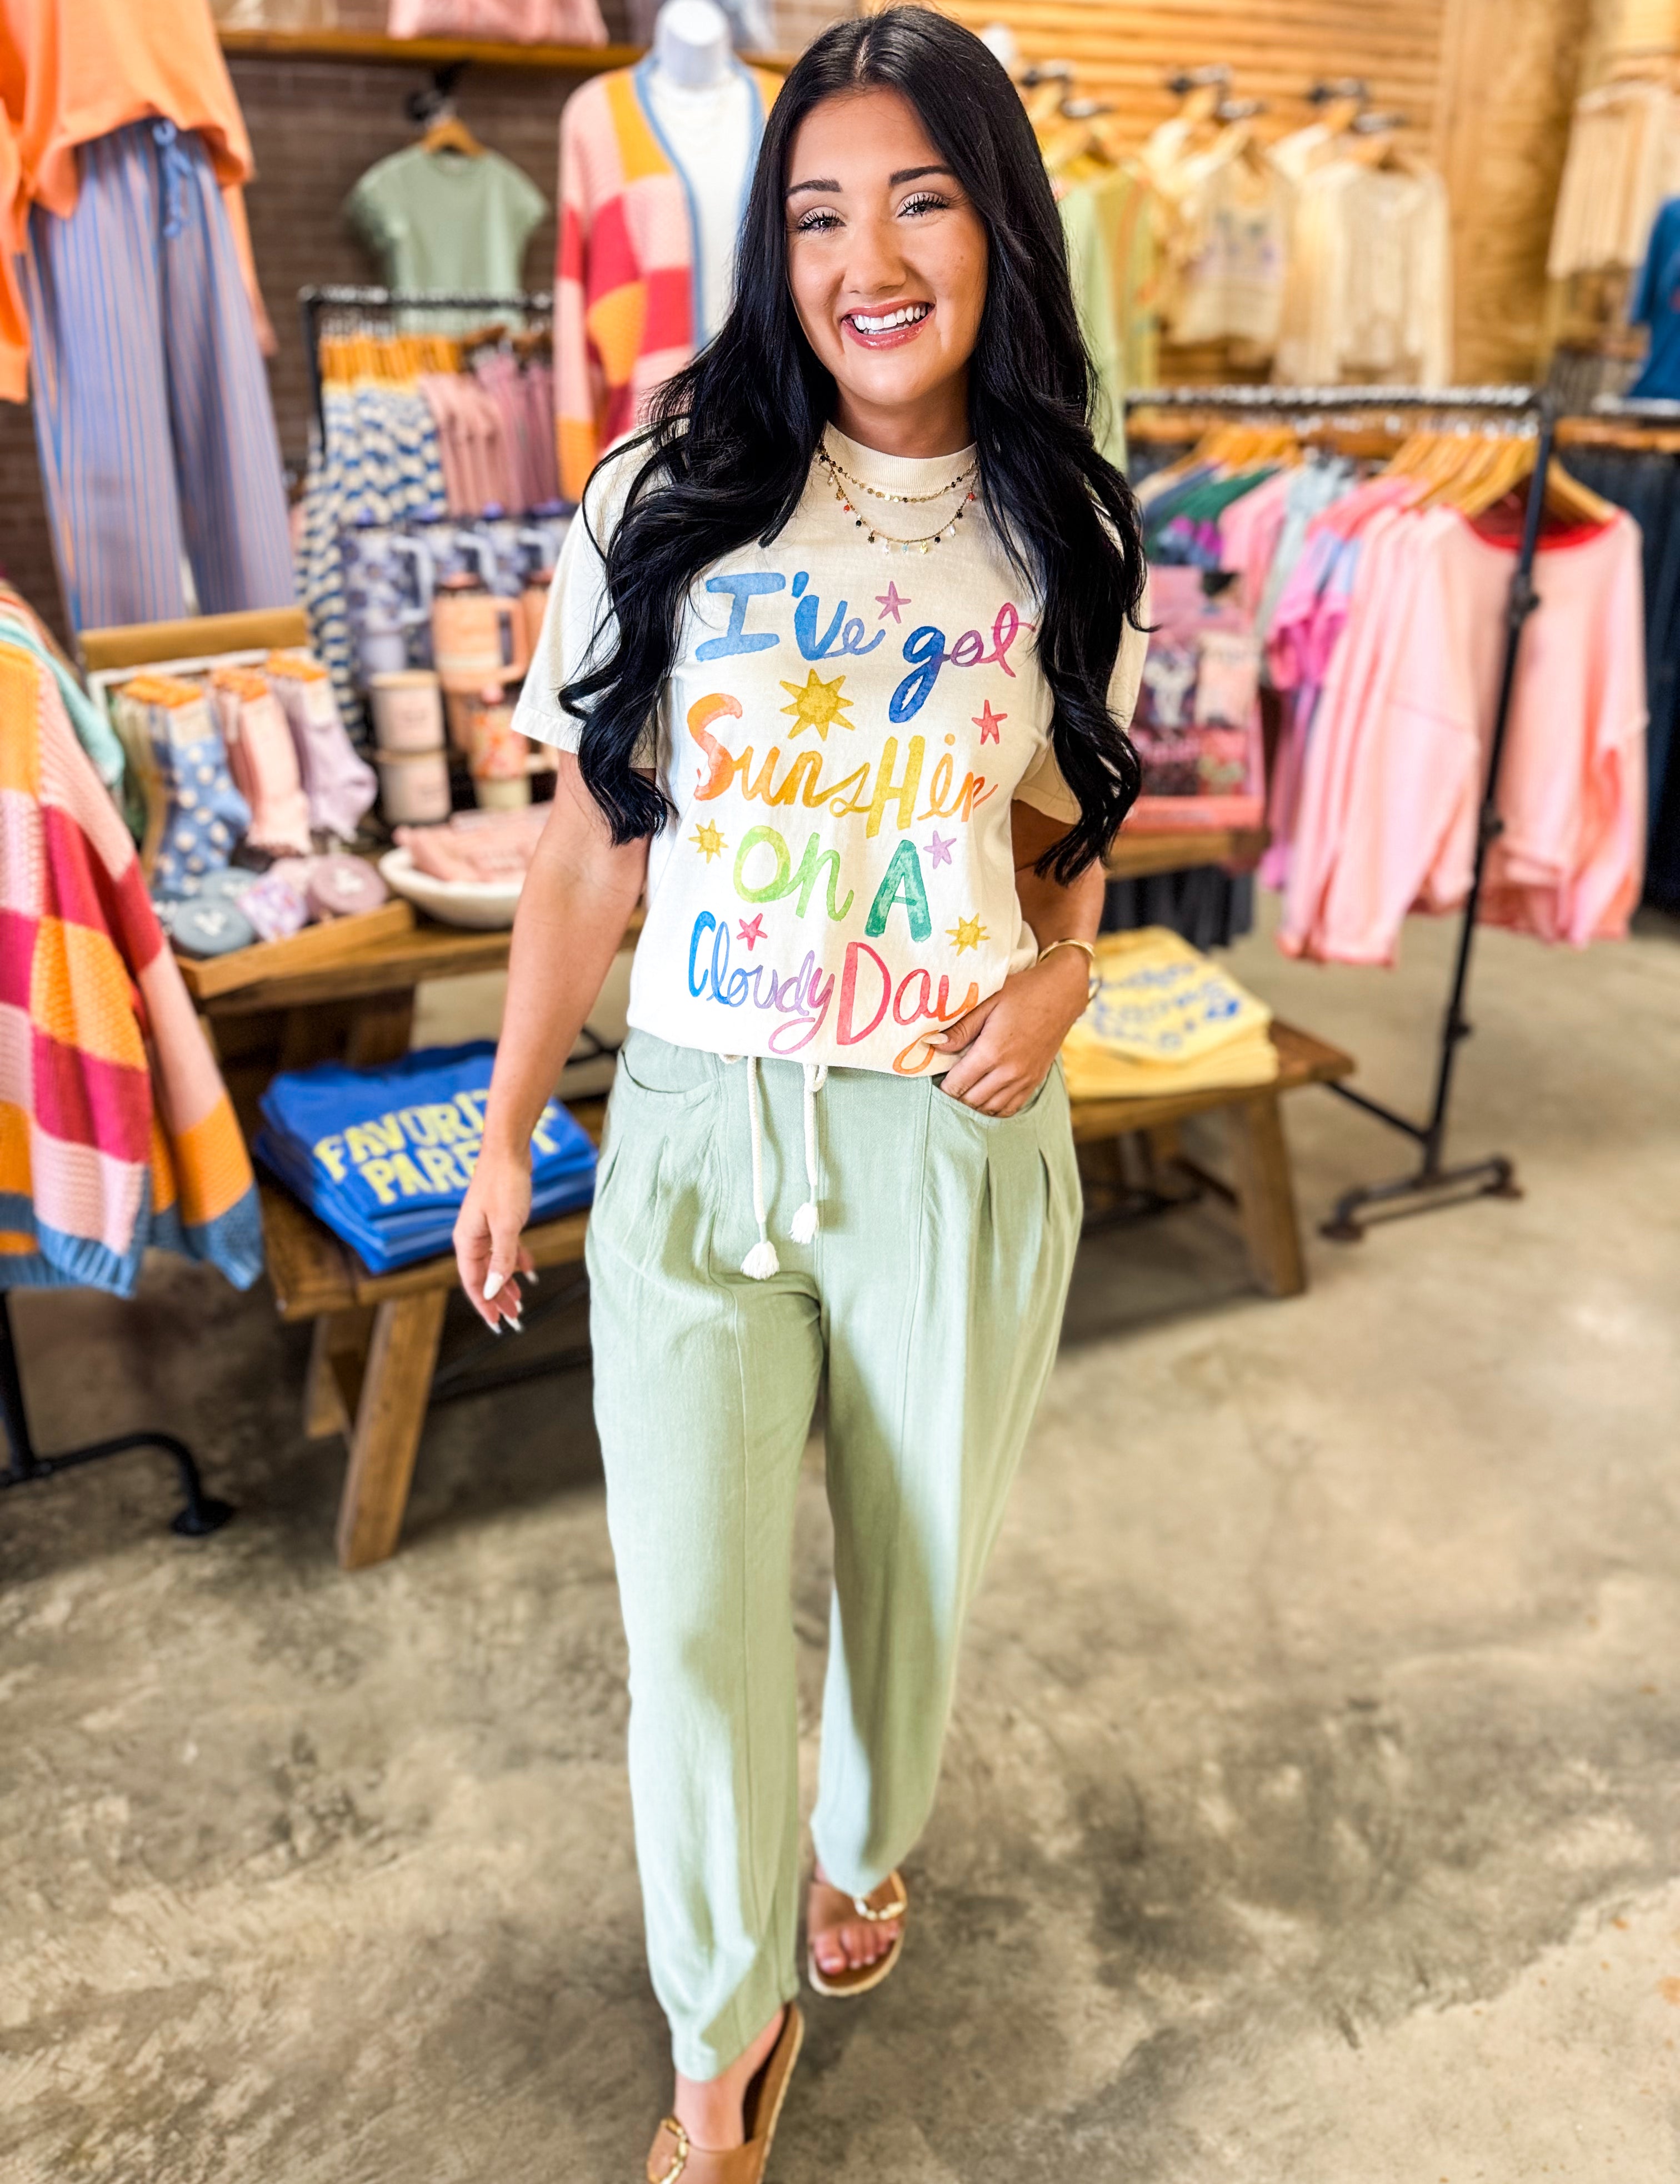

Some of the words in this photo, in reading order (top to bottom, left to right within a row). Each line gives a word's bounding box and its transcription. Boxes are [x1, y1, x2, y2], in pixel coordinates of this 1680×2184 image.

[695, 571, 886, 662] I've
[889, 602, 1035, 724] got
[864, 839, 932, 942] A
[688, 911, 836, 1054] Cloudy
[836, 941, 979, 1075] Day
[312, 1089, 489, 1183] FAVORI
